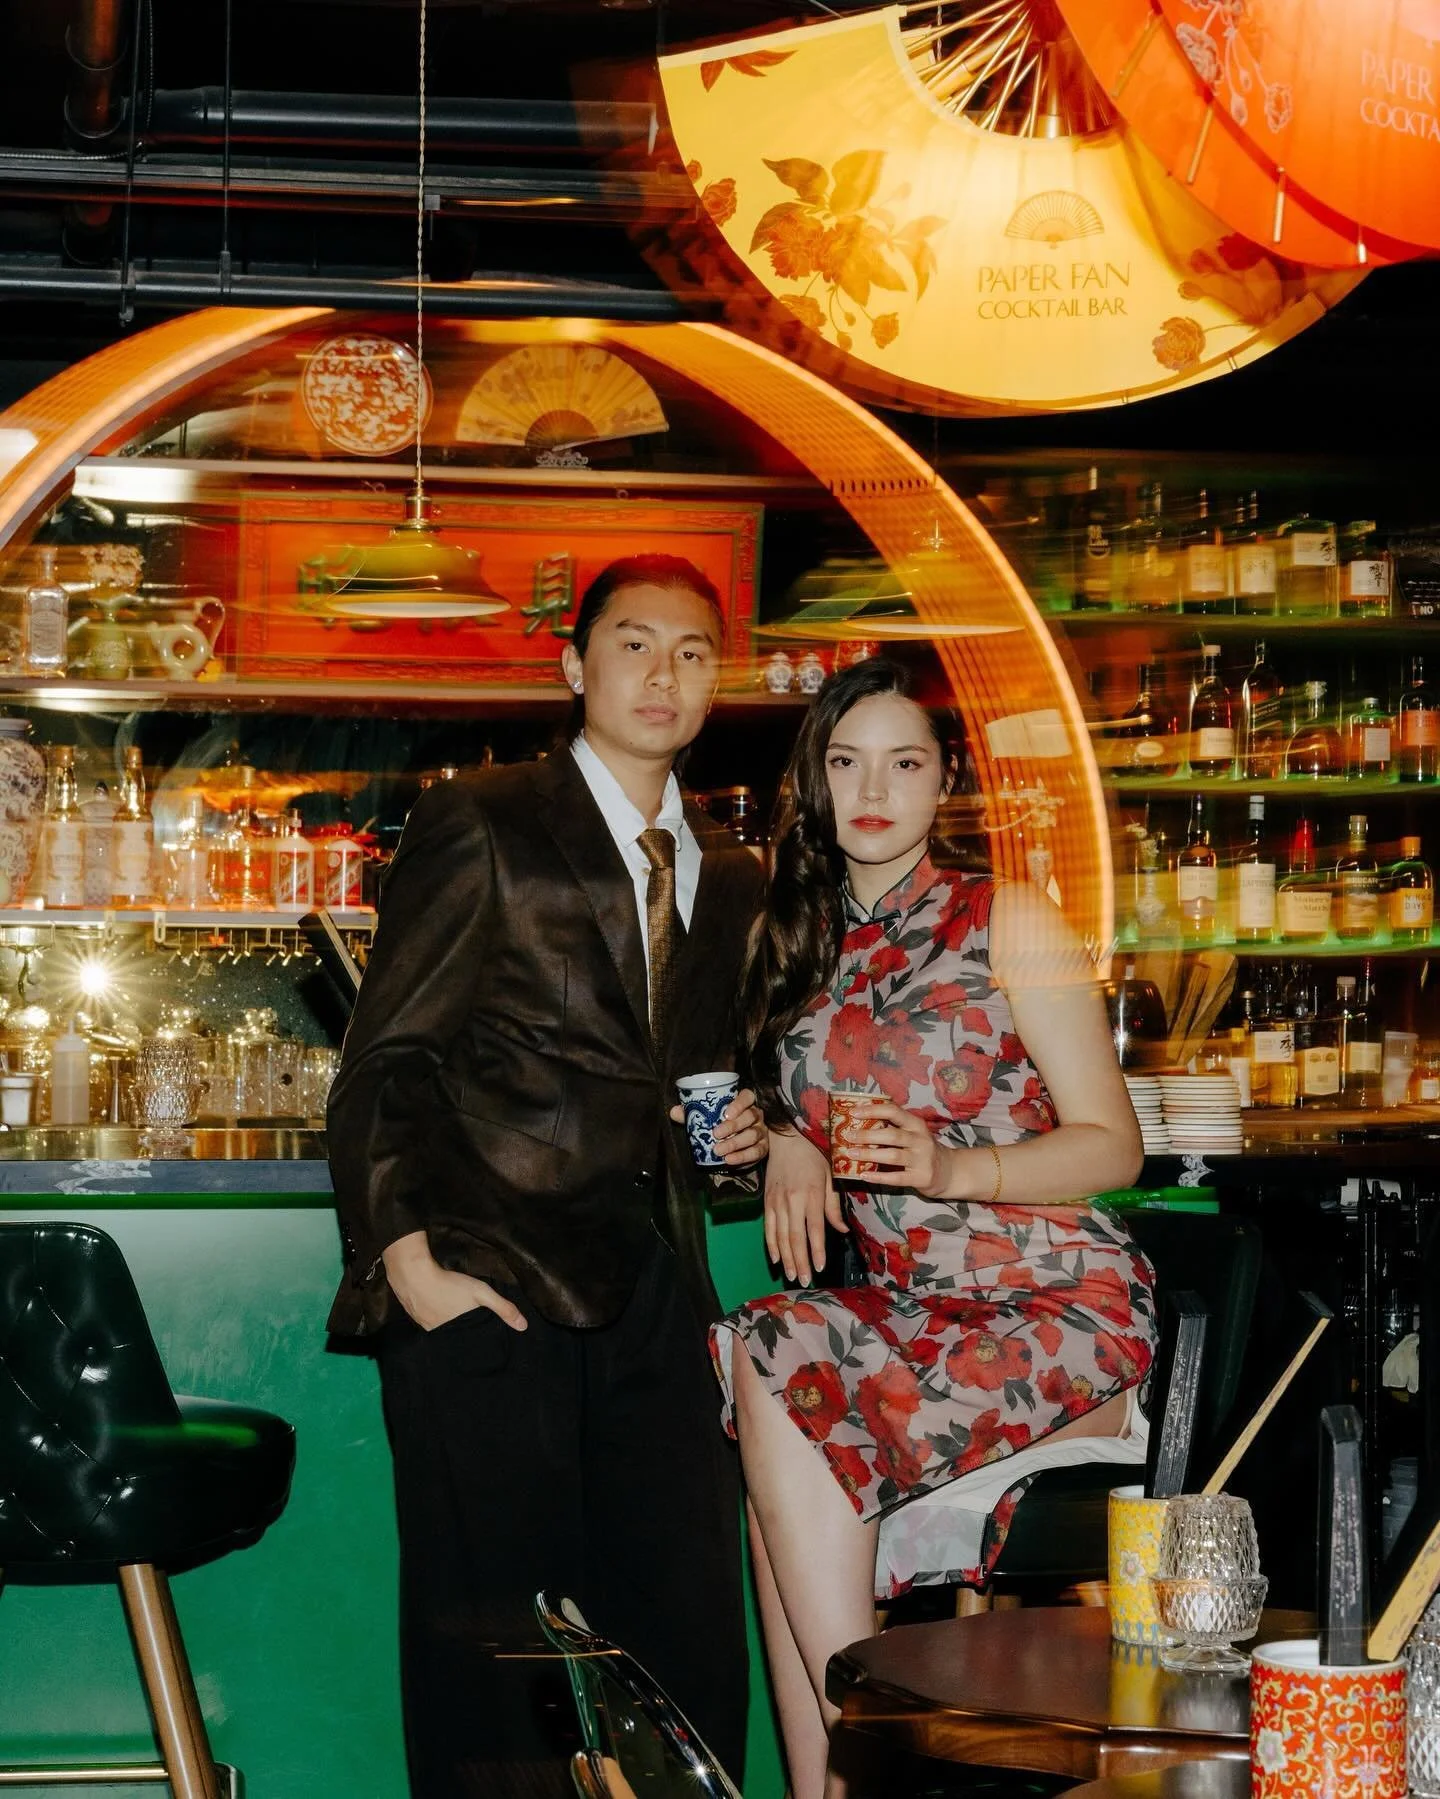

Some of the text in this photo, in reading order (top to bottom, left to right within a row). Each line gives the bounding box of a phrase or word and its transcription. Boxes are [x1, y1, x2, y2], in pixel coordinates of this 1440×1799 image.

[1360, 47, 1437, 107] PAPER
[978, 262, 1131, 293] PAPER FAN
[977, 297, 1128, 320] COCKTAIL BAR
